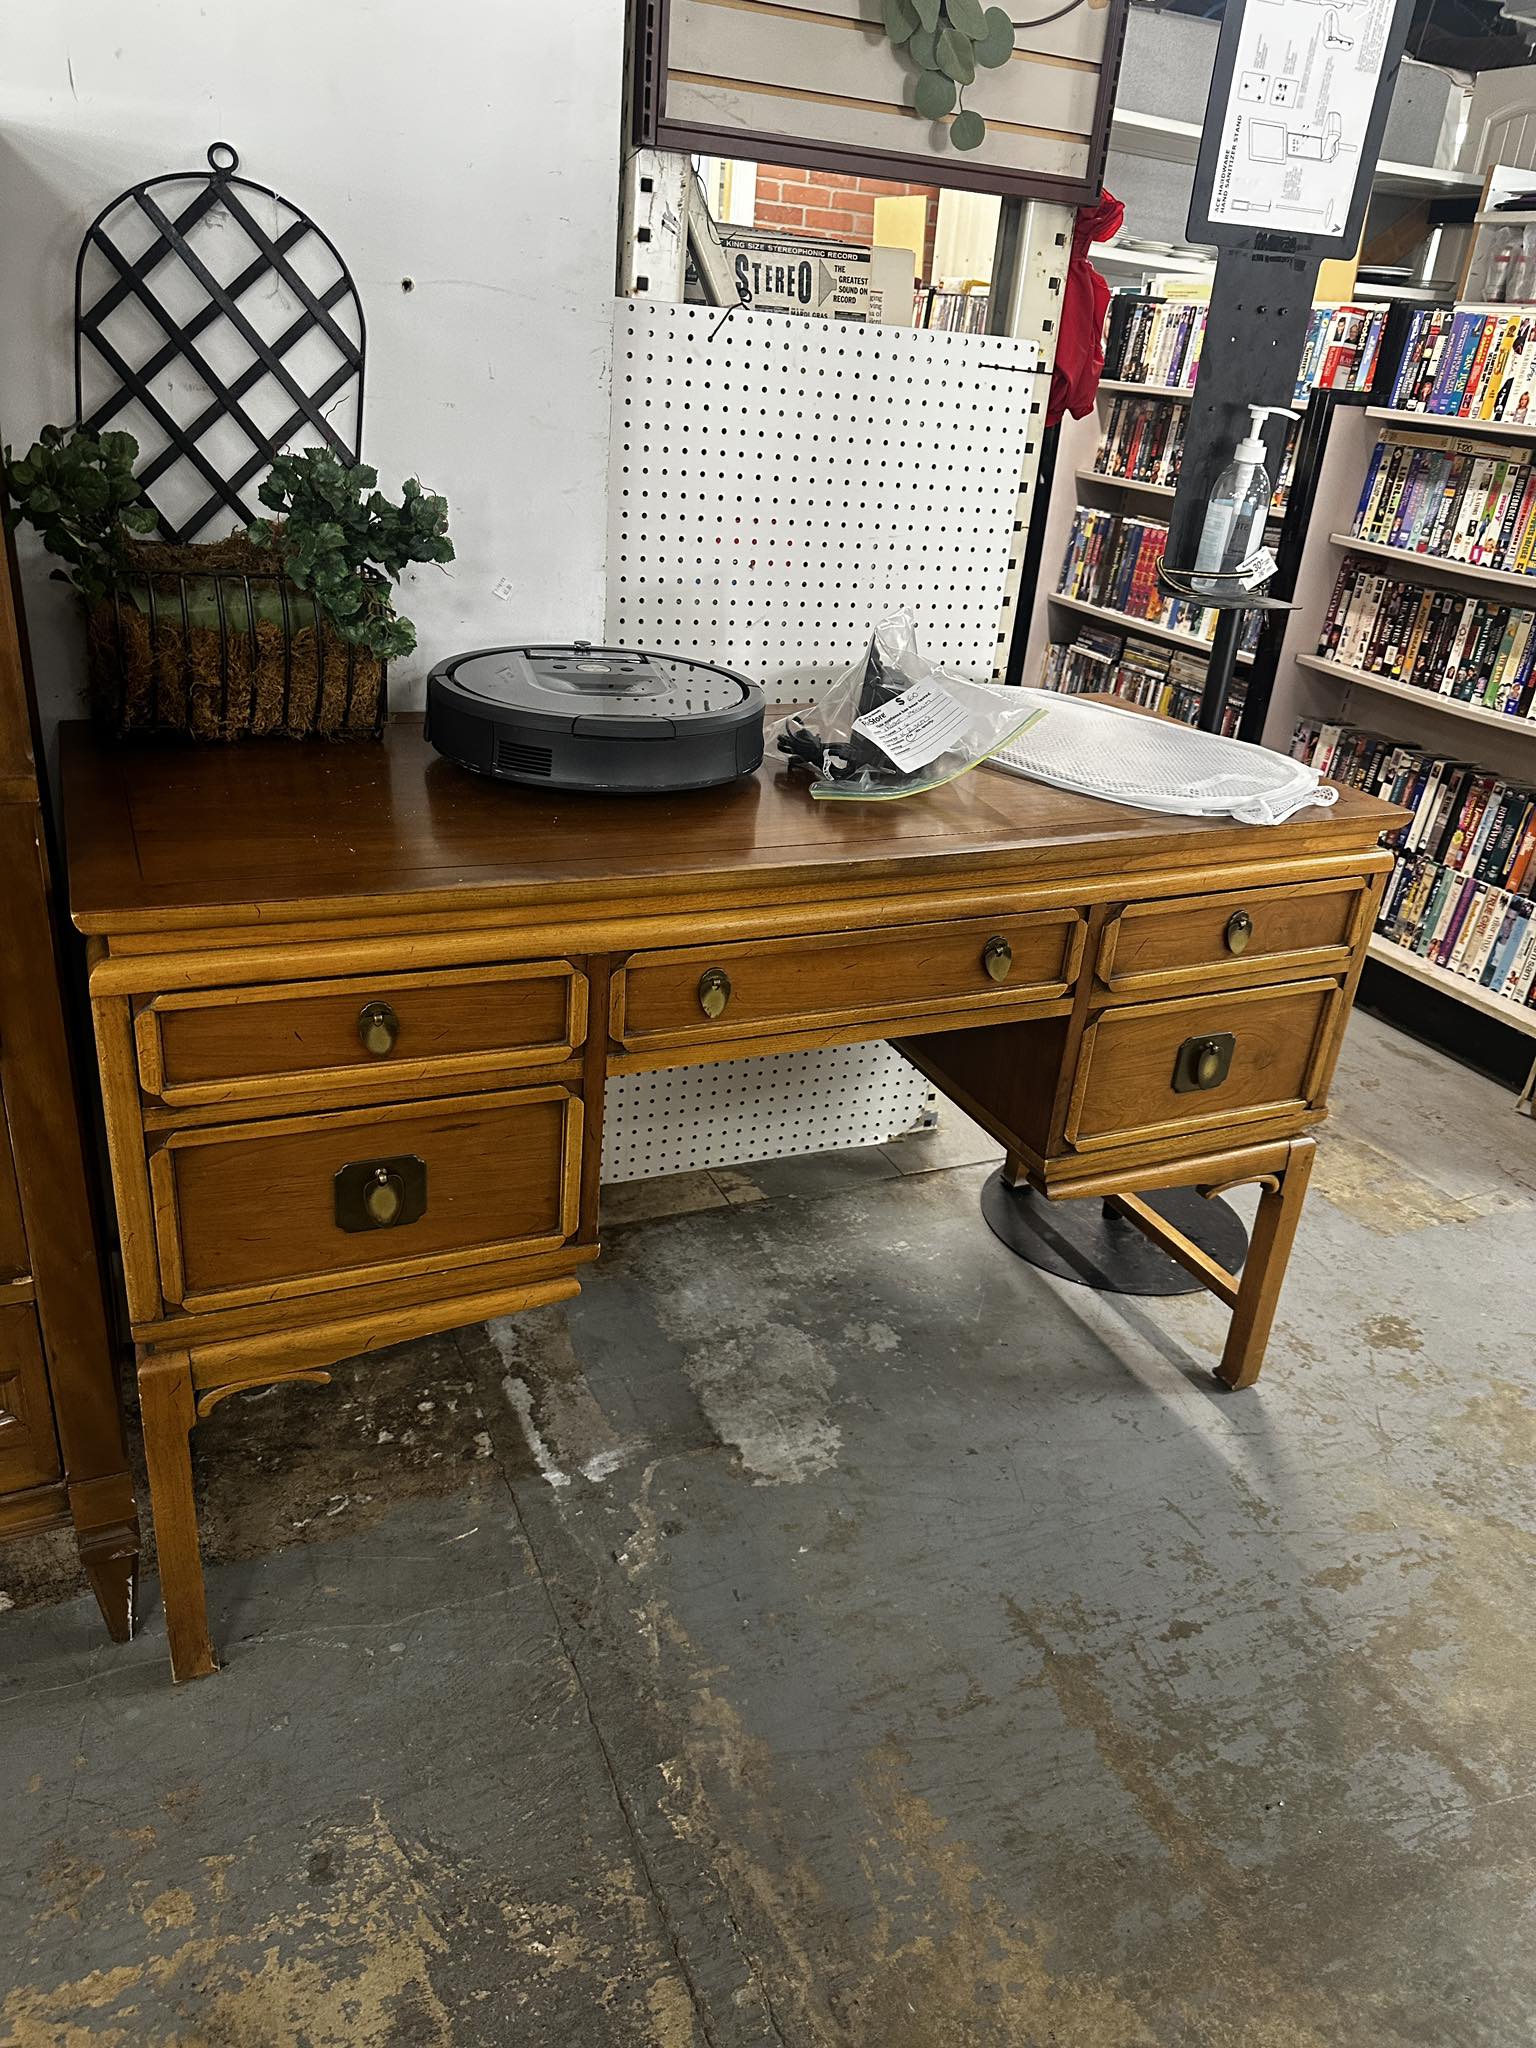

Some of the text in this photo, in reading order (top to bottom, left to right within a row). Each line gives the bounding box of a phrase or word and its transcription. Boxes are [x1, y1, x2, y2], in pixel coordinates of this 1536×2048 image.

[1217, 149, 1230, 194] HARDWARE
[1219, 114, 1242, 213] HAND SANITIZER STAND
[727, 241, 745, 249] KING
[768, 245, 825, 257] STEREOPHONIC
[828, 252, 858, 260] RECORD
[735, 254, 811, 303] STEREO
[835, 265, 845, 273] THE
[839, 276, 868, 285] GREATEST
[839, 286, 858, 294] SOUND
[833, 295, 856, 304] RECORD
[1356, 310, 1373, 351] Scotch
[1457, 443, 1472, 453] T-120
[1505, 477, 1526, 521] INDEPENDENCE
[1473, 892, 1498, 937] TRUE GRIT
[1521, 960, 1535, 981] sam
